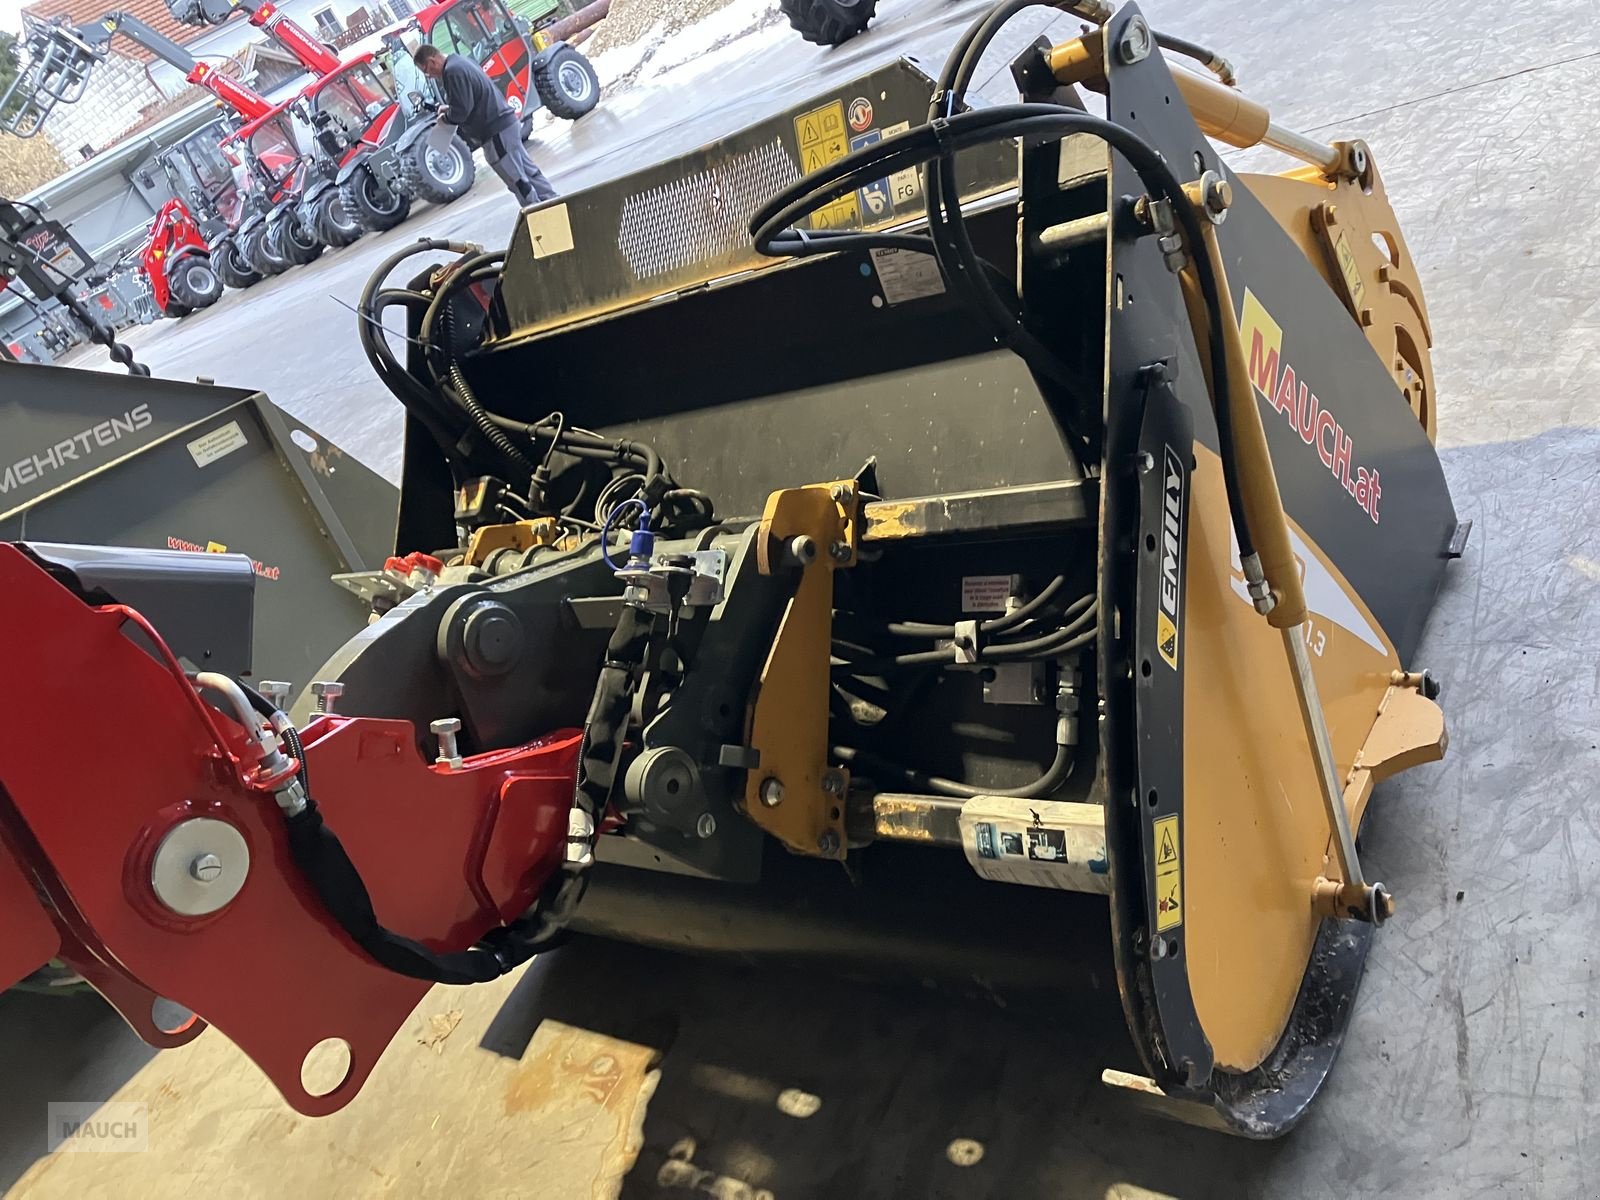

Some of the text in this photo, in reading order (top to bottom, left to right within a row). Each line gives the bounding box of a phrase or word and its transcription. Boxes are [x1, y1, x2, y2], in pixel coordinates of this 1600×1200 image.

[283, 20, 323, 56] WEIDEMANN
[897, 184, 914, 199] FG
[1248, 326, 1382, 524] MAUCH.at
[1162, 457, 1183, 616] EMILY
[1305, 619, 1326, 657] 1.3
